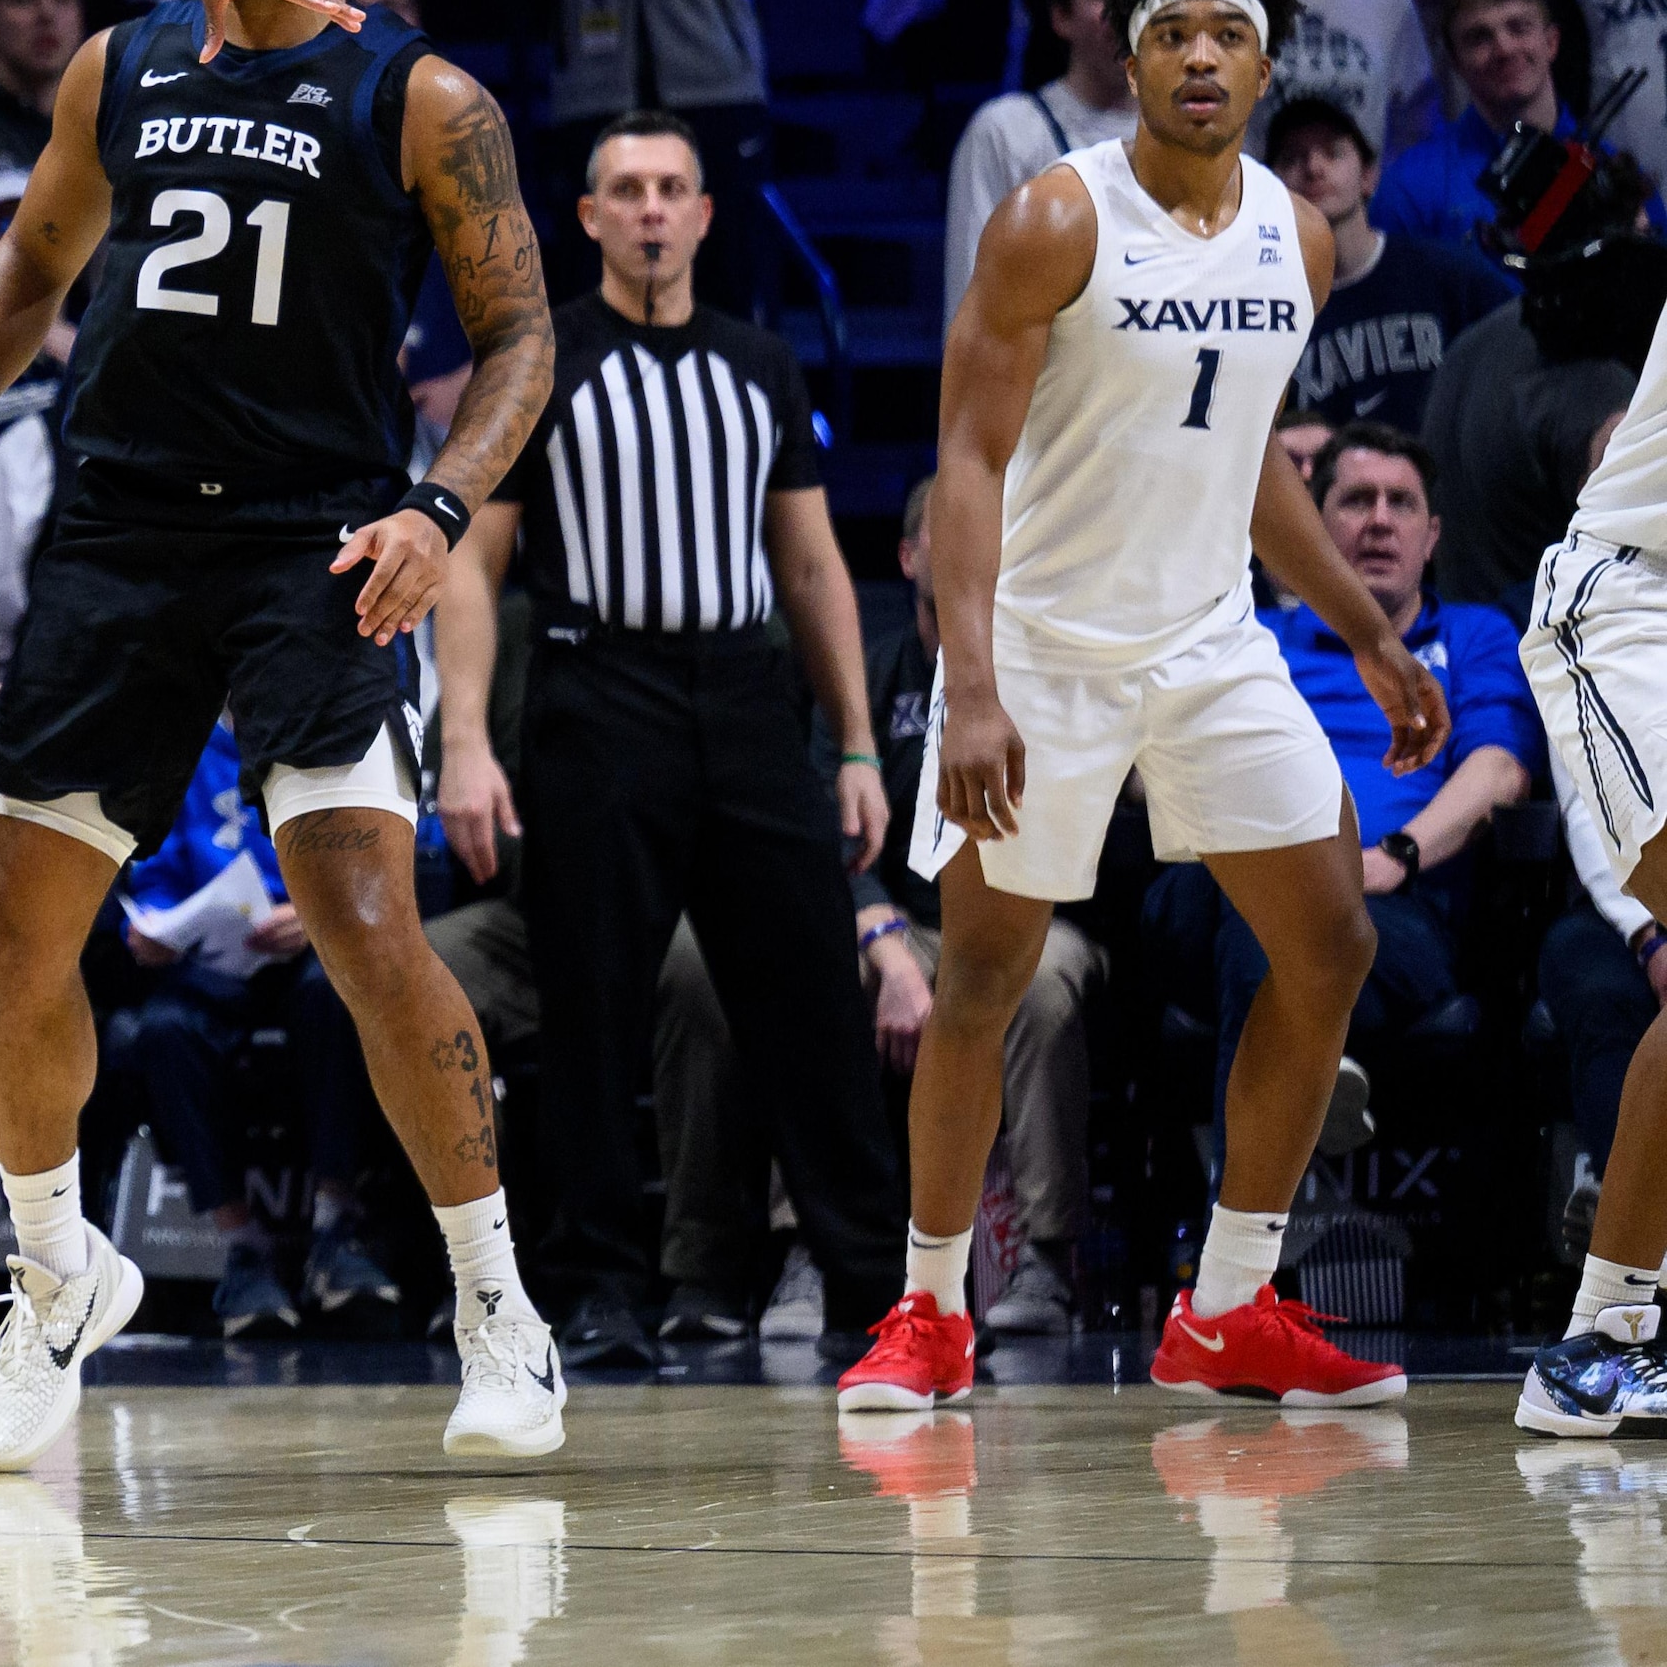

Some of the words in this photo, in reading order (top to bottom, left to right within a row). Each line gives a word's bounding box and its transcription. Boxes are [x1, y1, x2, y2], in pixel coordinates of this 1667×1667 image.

[134, 117, 321, 179] BUTLER
[136, 189, 291, 326] 21
[1112, 298, 1297, 332] XAVIER
[1180, 348, 1224, 430] 1
[1291, 312, 1445, 412] XAVIER
[454, 1030, 478, 1072] 3
